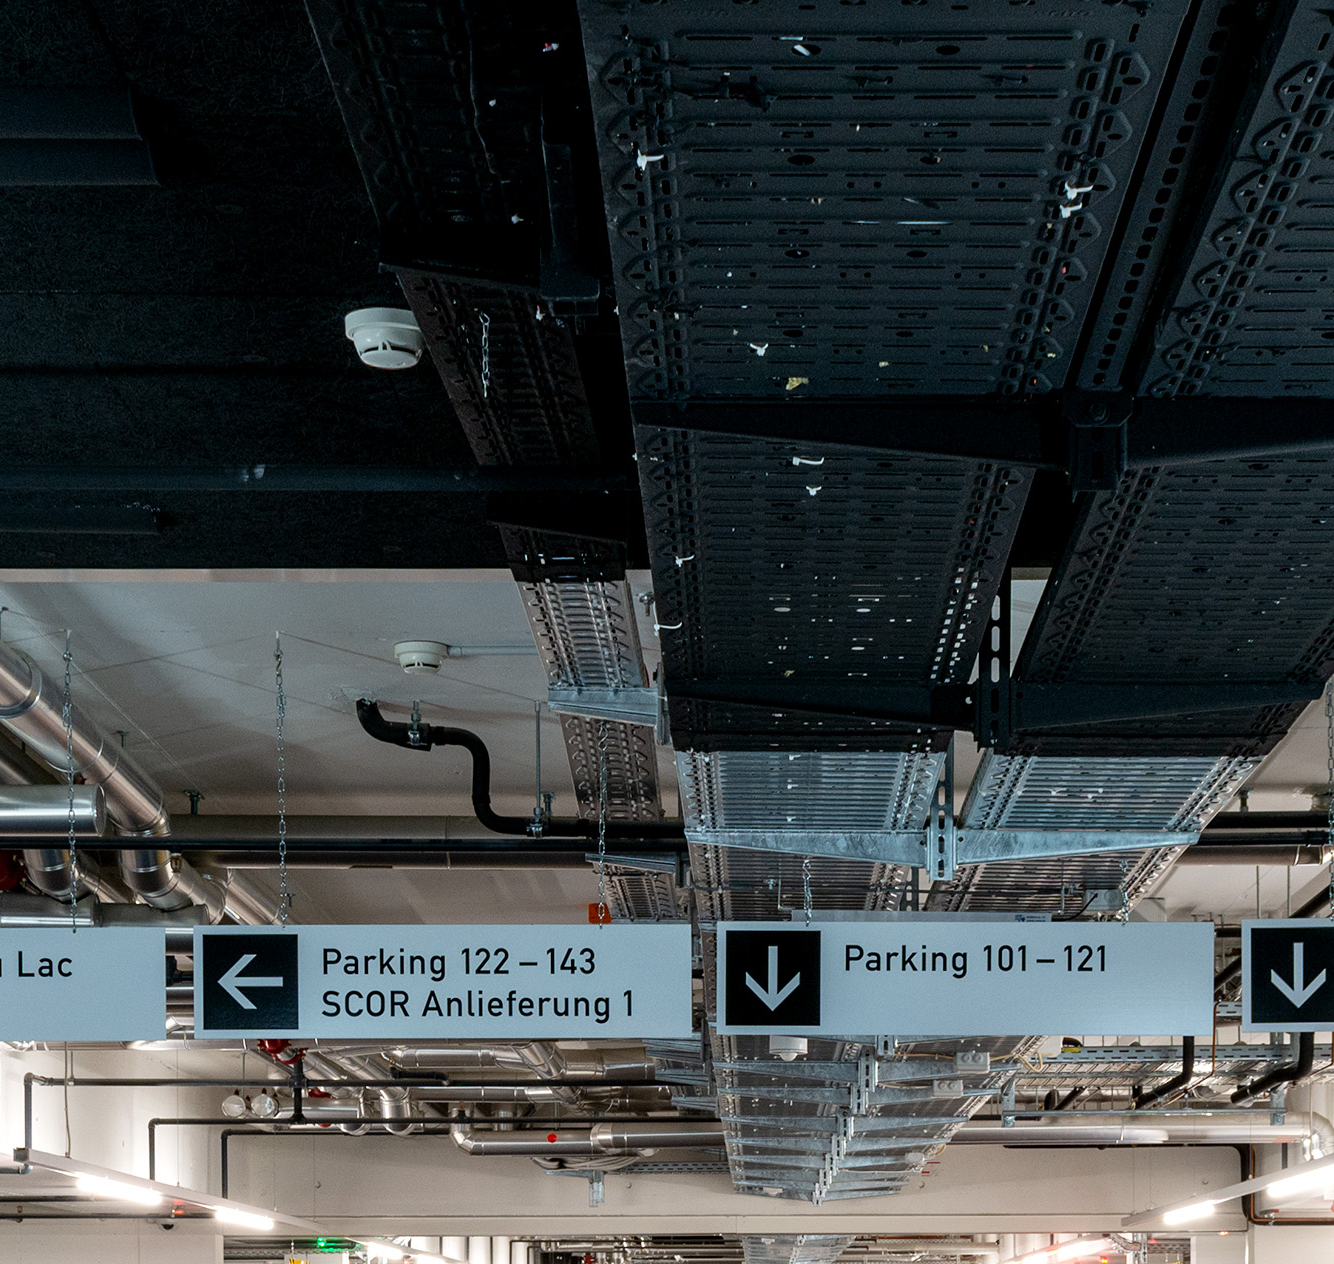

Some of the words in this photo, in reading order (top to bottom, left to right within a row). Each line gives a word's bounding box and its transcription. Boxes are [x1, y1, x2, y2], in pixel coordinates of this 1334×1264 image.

[18, 951, 72, 977] Lac
[323, 948, 445, 981] Parking
[846, 945, 967, 978] Parking
[322, 991, 409, 1017] SCOR
[422, 990, 609, 1023] Anlieferung
[624, 990, 631, 1016] 1
